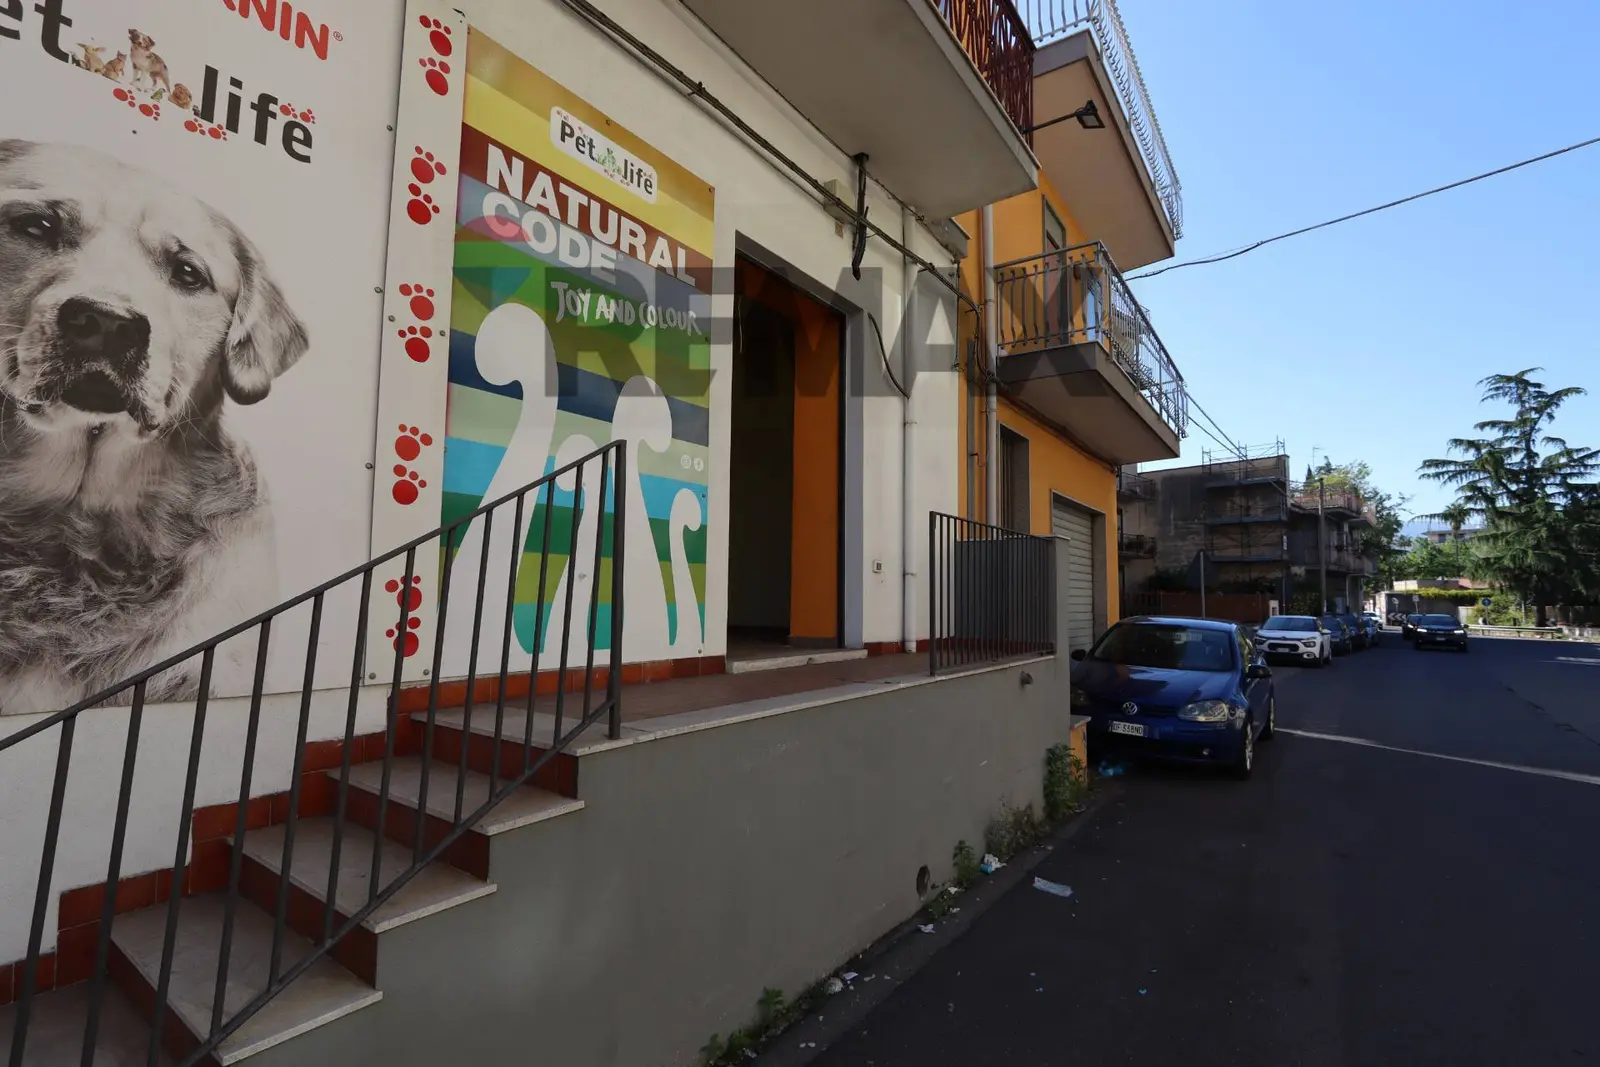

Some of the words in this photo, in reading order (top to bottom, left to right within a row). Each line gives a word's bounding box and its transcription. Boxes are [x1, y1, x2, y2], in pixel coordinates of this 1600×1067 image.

[200, 64, 313, 163] life
[560, 119, 596, 162] Pet
[621, 158, 654, 196] life
[482, 191, 617, 285] CODE
[486, 143, 696, 287] NATURAL
[550, 281, 591, 324] JOY
[595, 294, 636, 326] AND
[638, 301, 702, 337] COLOUR
